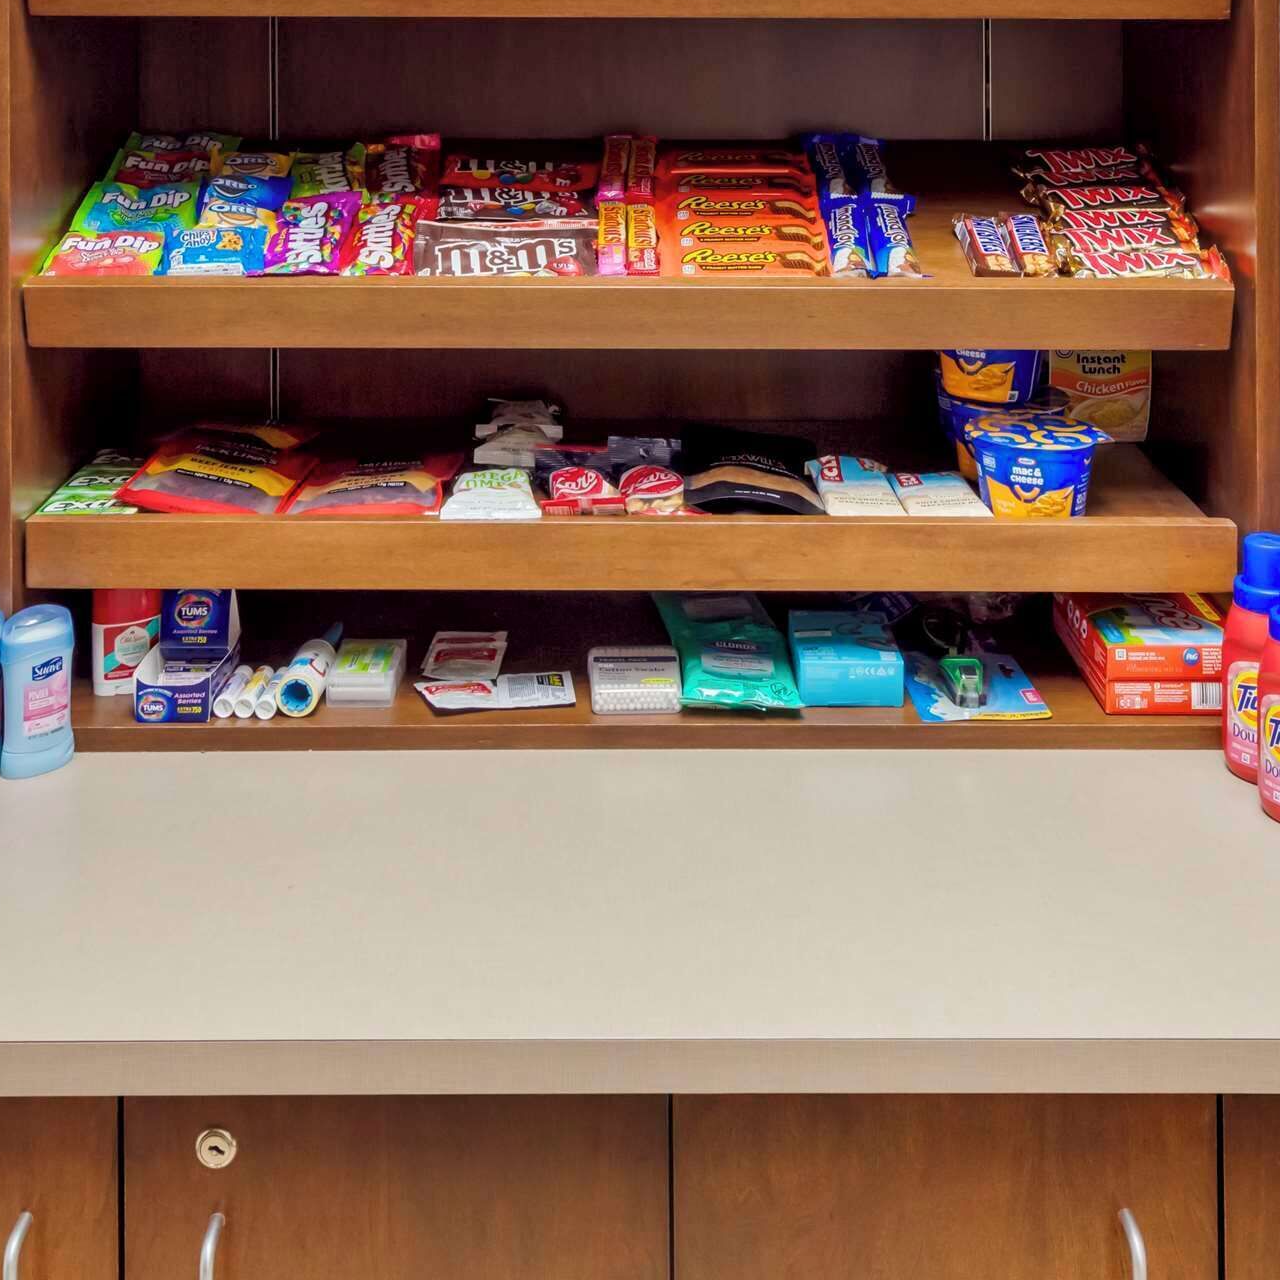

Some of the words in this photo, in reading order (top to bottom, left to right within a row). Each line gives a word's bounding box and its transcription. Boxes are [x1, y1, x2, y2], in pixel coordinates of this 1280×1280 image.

[124, 155, 169, 173] Fun
[171, 157, 210, 174] Dip
[223, 155, 278, 167] OREO
[1026, 148, 1137, 172] TWIX
[212, 177, 258, 190] OREO
[100, 191, 146, 211] Fun
[150, 189, 191, 209] Dip
[677, 196, 767, 210] Reese's
[1046, 185, 1160, 209] TWIX
[680, 221, 773, 236] Reese's
[1060, 208, 1167, 231] TWIX
[284, 201, 329, 264] Skittles
[358, 204, 402, 269] Skittles
[1010, 214, 1045, 253] SNICKERS
[1051, 226, 1176, 254] TWIX
[59, 235, 110, 252] Fun
[113, 234, 161, 253] Dip
[682, 248, 777, 263] Reese's
[1071, 250, 1200, 276] TWIX
[1076, 352, 1127, 366] Instant
[1081, 363, 1121, 376] Lunch
[1075, 378, 1125, 396] Chicken
[1011, 465, 1034, 477] mac
[1033, 467, 1042, 478] &
[180, 606, 209, 617] TUMS
[33, 659, 62, 677] Suave
[173, 691, 206, 699] Assorted
[142, 703, 164, 713] TUMS
